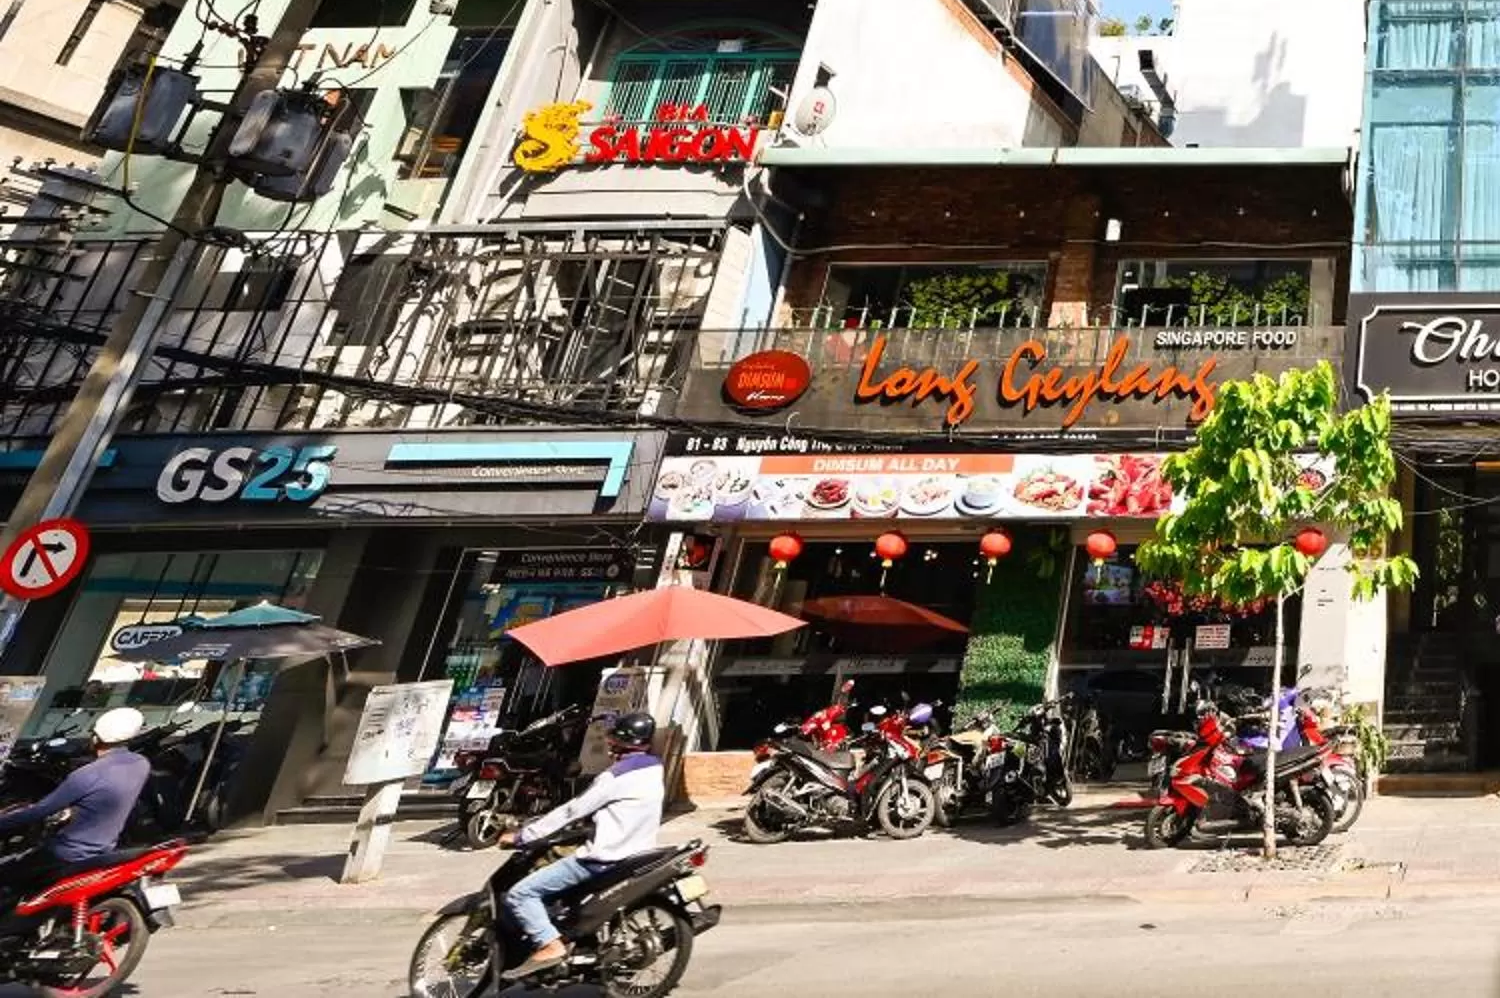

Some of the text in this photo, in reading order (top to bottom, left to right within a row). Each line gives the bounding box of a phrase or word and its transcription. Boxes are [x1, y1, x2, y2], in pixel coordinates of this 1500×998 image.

[585, 126, 758, 162] SAIGON
[1156, 330, 1297, 345] SINGAPORE FOOD
[857, 333, 1217, 428] Long Geylang
[156, 445, 336, 503] GS25
[813, 457, 961, 471] DIMSUM ALL DAY
